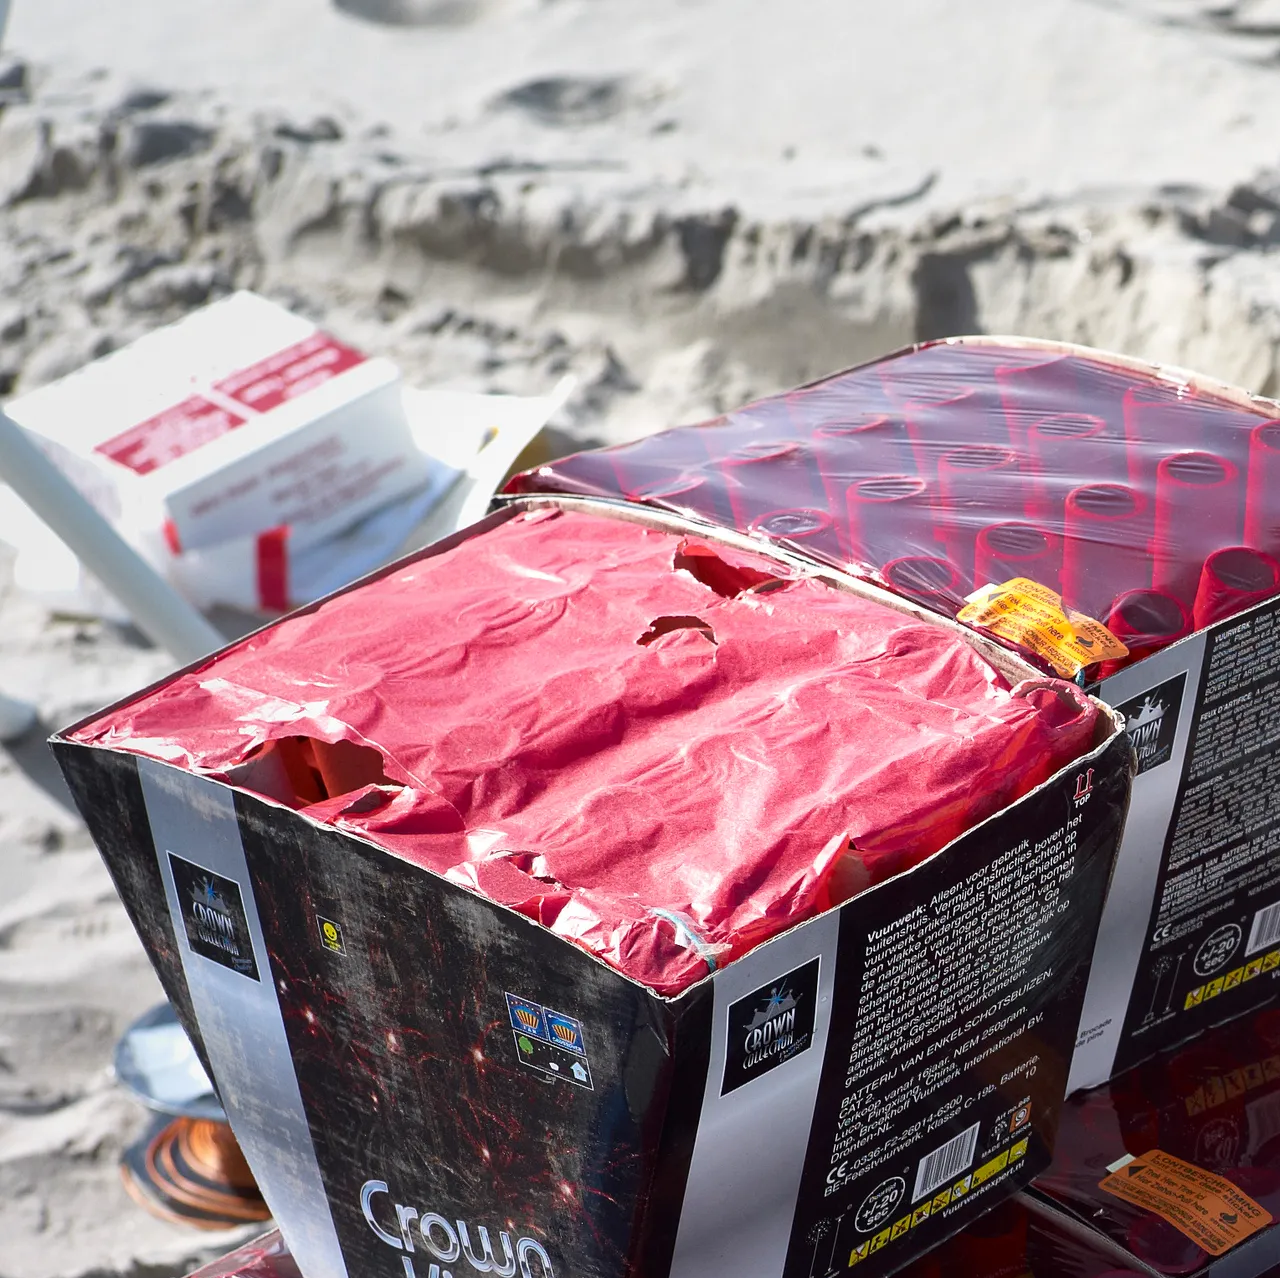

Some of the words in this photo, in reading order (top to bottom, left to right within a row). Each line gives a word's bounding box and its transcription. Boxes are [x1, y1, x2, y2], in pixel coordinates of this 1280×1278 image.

[1074, 793, 1091, 808] TOP
[192, 901, 236, 939] CROWN
[744, 1007, 796, 1054] CROWN
[742, 1031, 794, 1070] COLLECTION
[861, 1189, 899, 1220] +/-20
[942, 1159, 1025, 1219] Vuurwerkexpert.nl
[866, 1206, 889, 1227] sec
